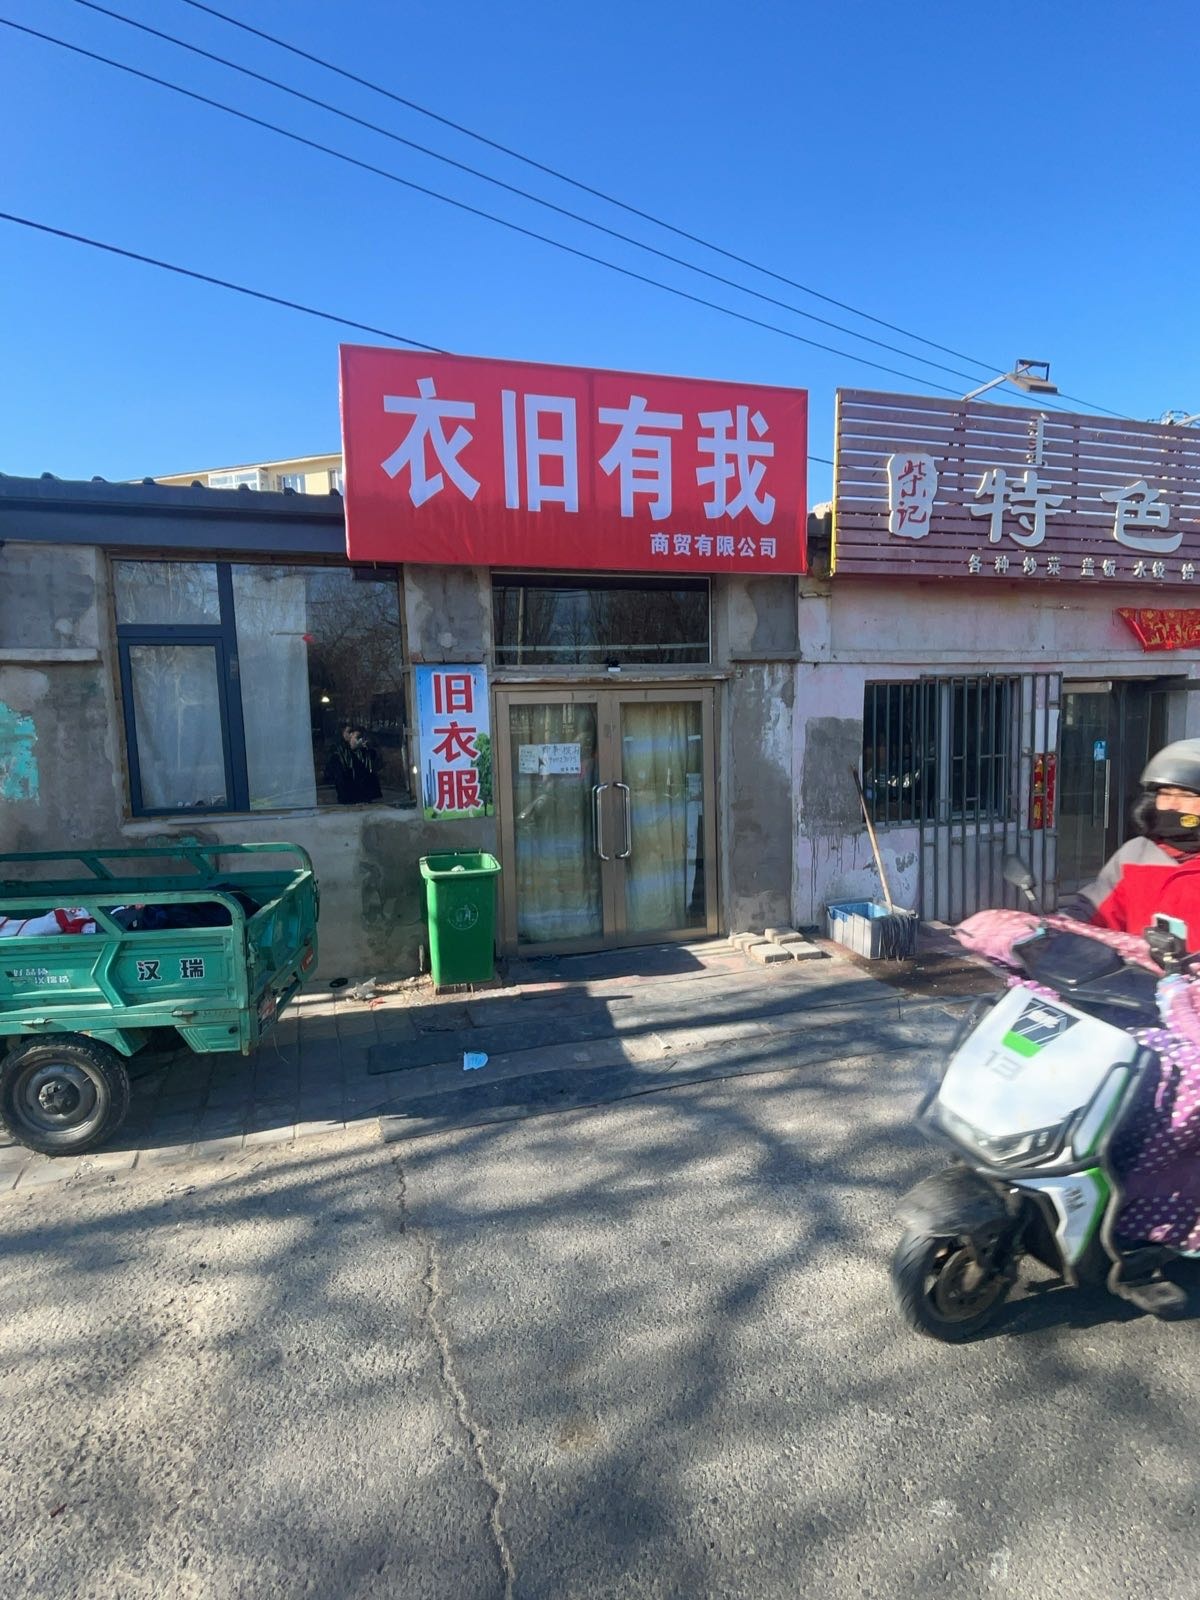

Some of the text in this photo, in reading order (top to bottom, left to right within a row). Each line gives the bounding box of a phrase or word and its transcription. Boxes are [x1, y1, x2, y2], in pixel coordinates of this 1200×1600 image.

[380, 376, 776, 526] 衣旧有我
[897, 459, 928, 531] 柴记
[969, 467, 1184, 554] 特色
[649, 531, 778, 559] 商贸有限公司
[432, 672, 482, 812] 旧衣服
[136, 957, 205, 982] 汉瑞
